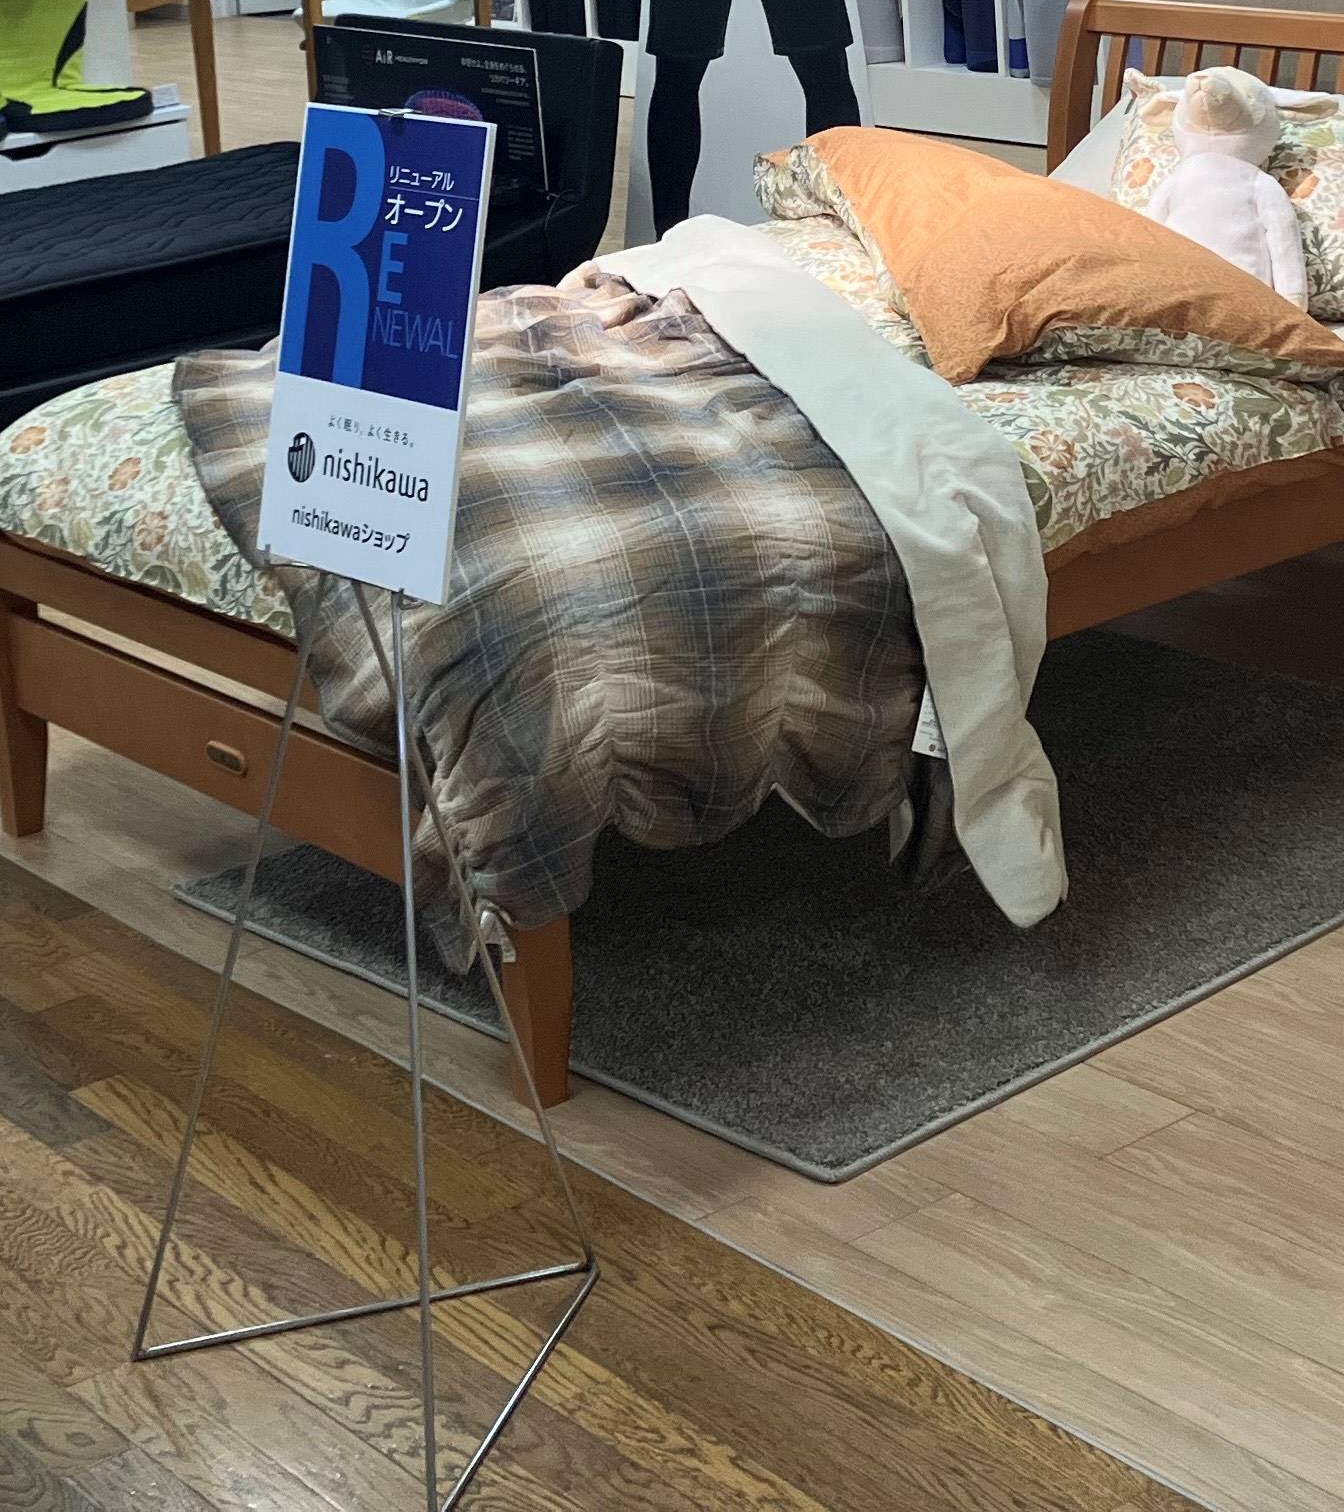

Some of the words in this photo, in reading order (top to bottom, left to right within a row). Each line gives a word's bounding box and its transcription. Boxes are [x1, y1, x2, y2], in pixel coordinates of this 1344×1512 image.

[389, 164, 455, 191] リニューアル
[384, 193, 464, 232] オープン
[322, 448, 430, 503] nishikawa
[291, 505, 411, 554] nishikawaショップ
